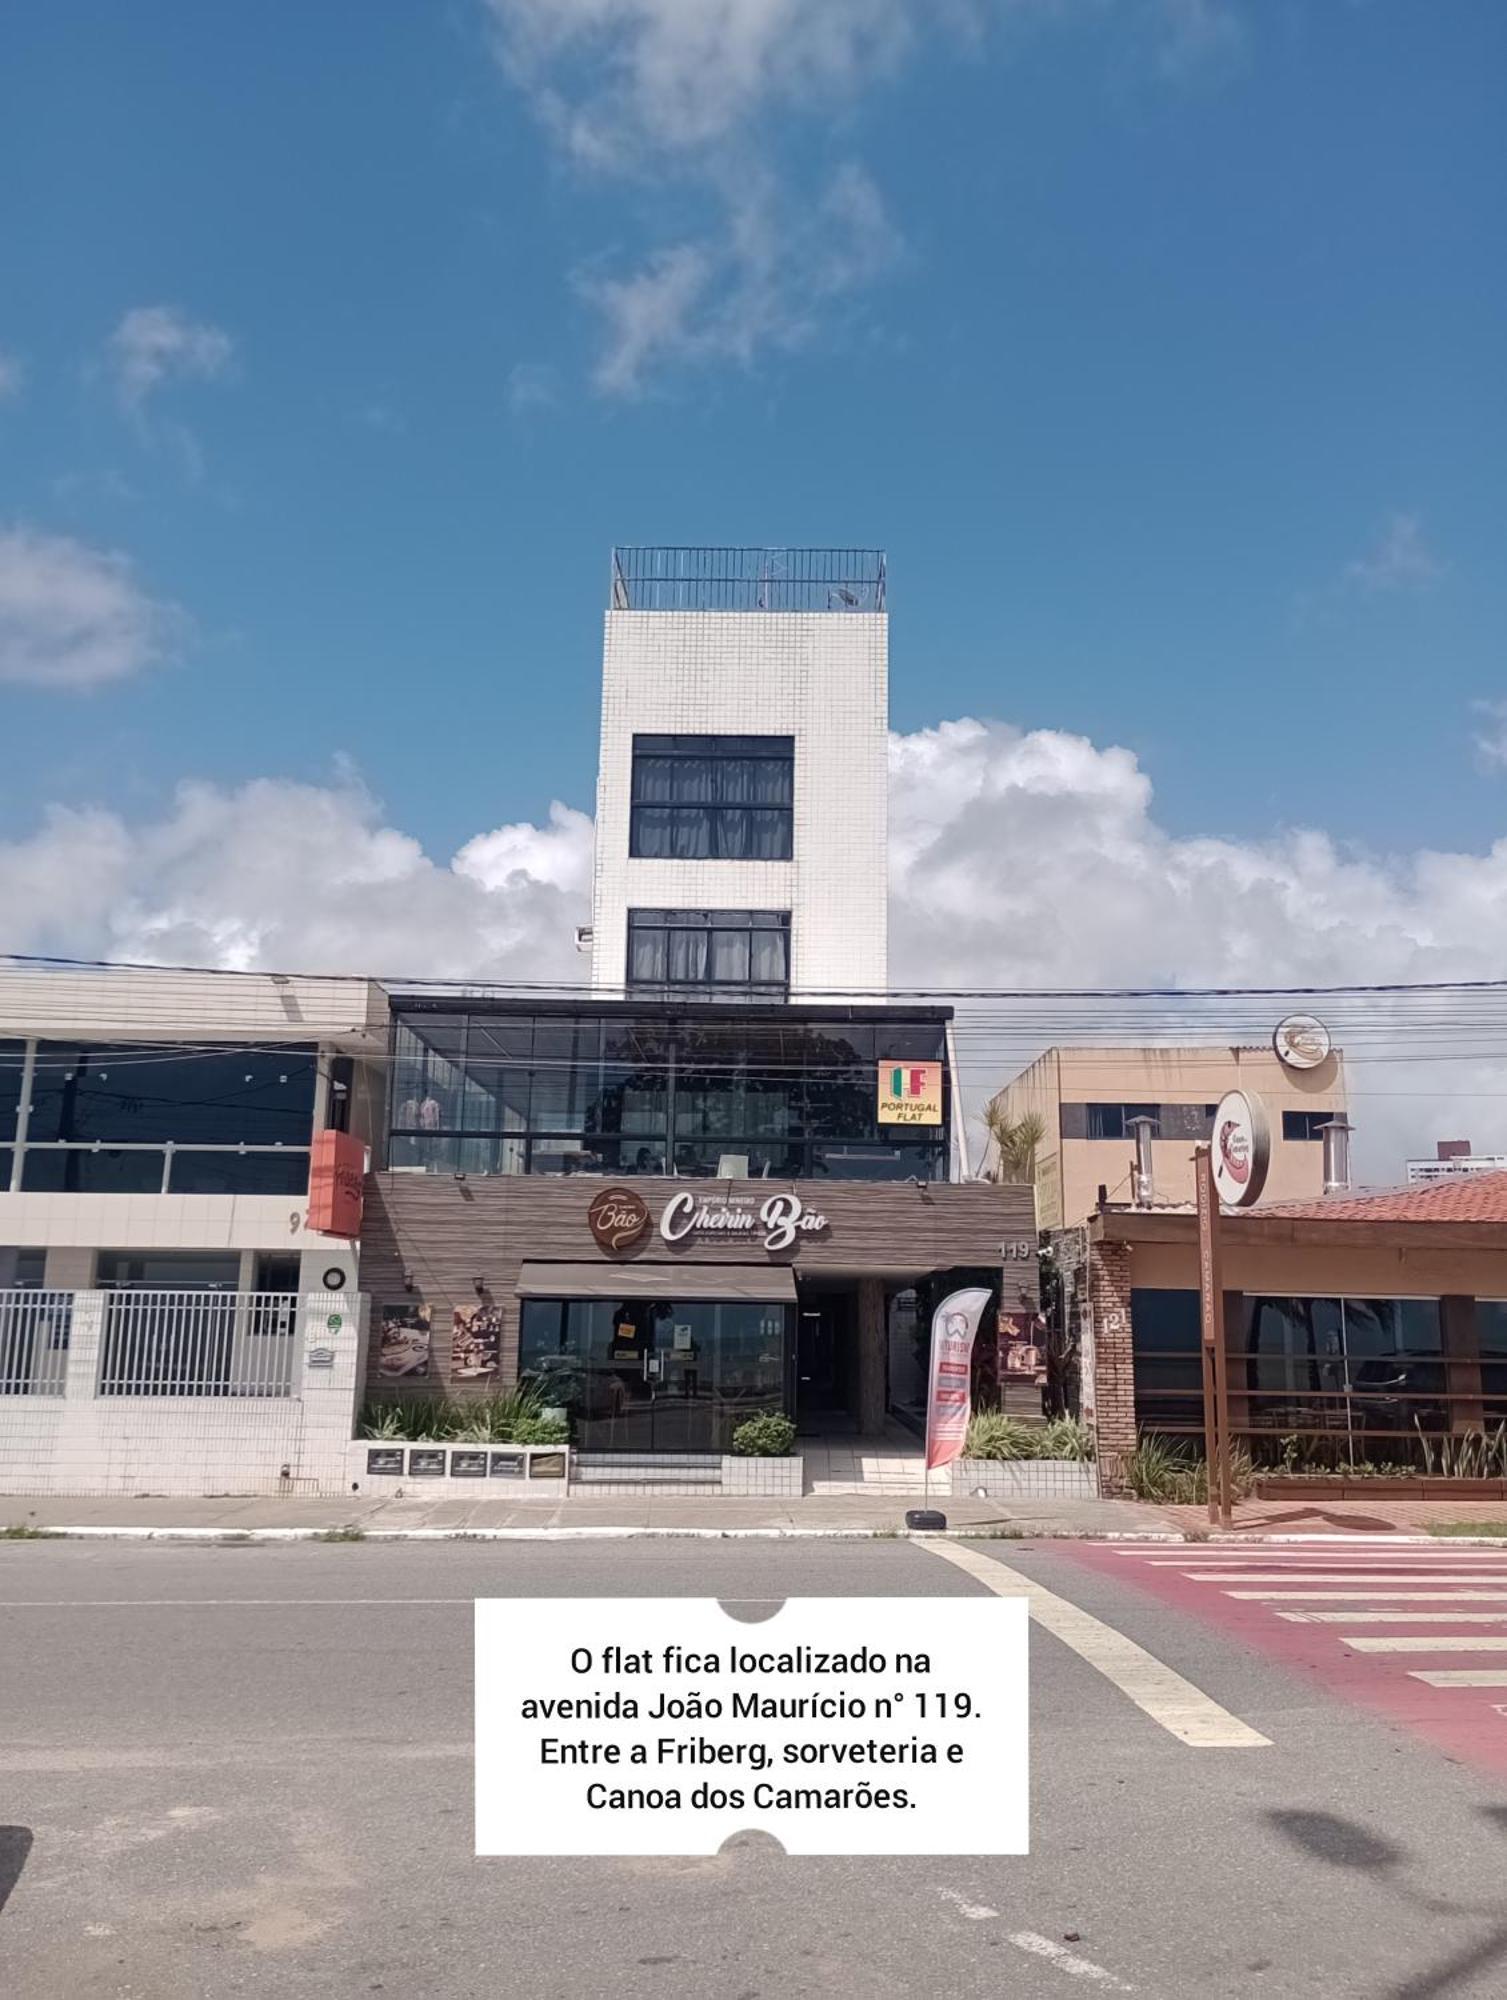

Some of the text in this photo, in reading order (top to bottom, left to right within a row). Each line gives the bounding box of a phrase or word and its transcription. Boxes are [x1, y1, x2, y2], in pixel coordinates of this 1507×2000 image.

[880, 1102, 939, 1113] PORTUGAL
[896, 1112, 924, 1121] FLAT
[591, 1202, 642, 1230] Bão
[660, 1191, 830, 1251] Cheirin Bão
[999, 1241, 1030, 1261] 119
[1102, 1308, 1127, 1335] 121
